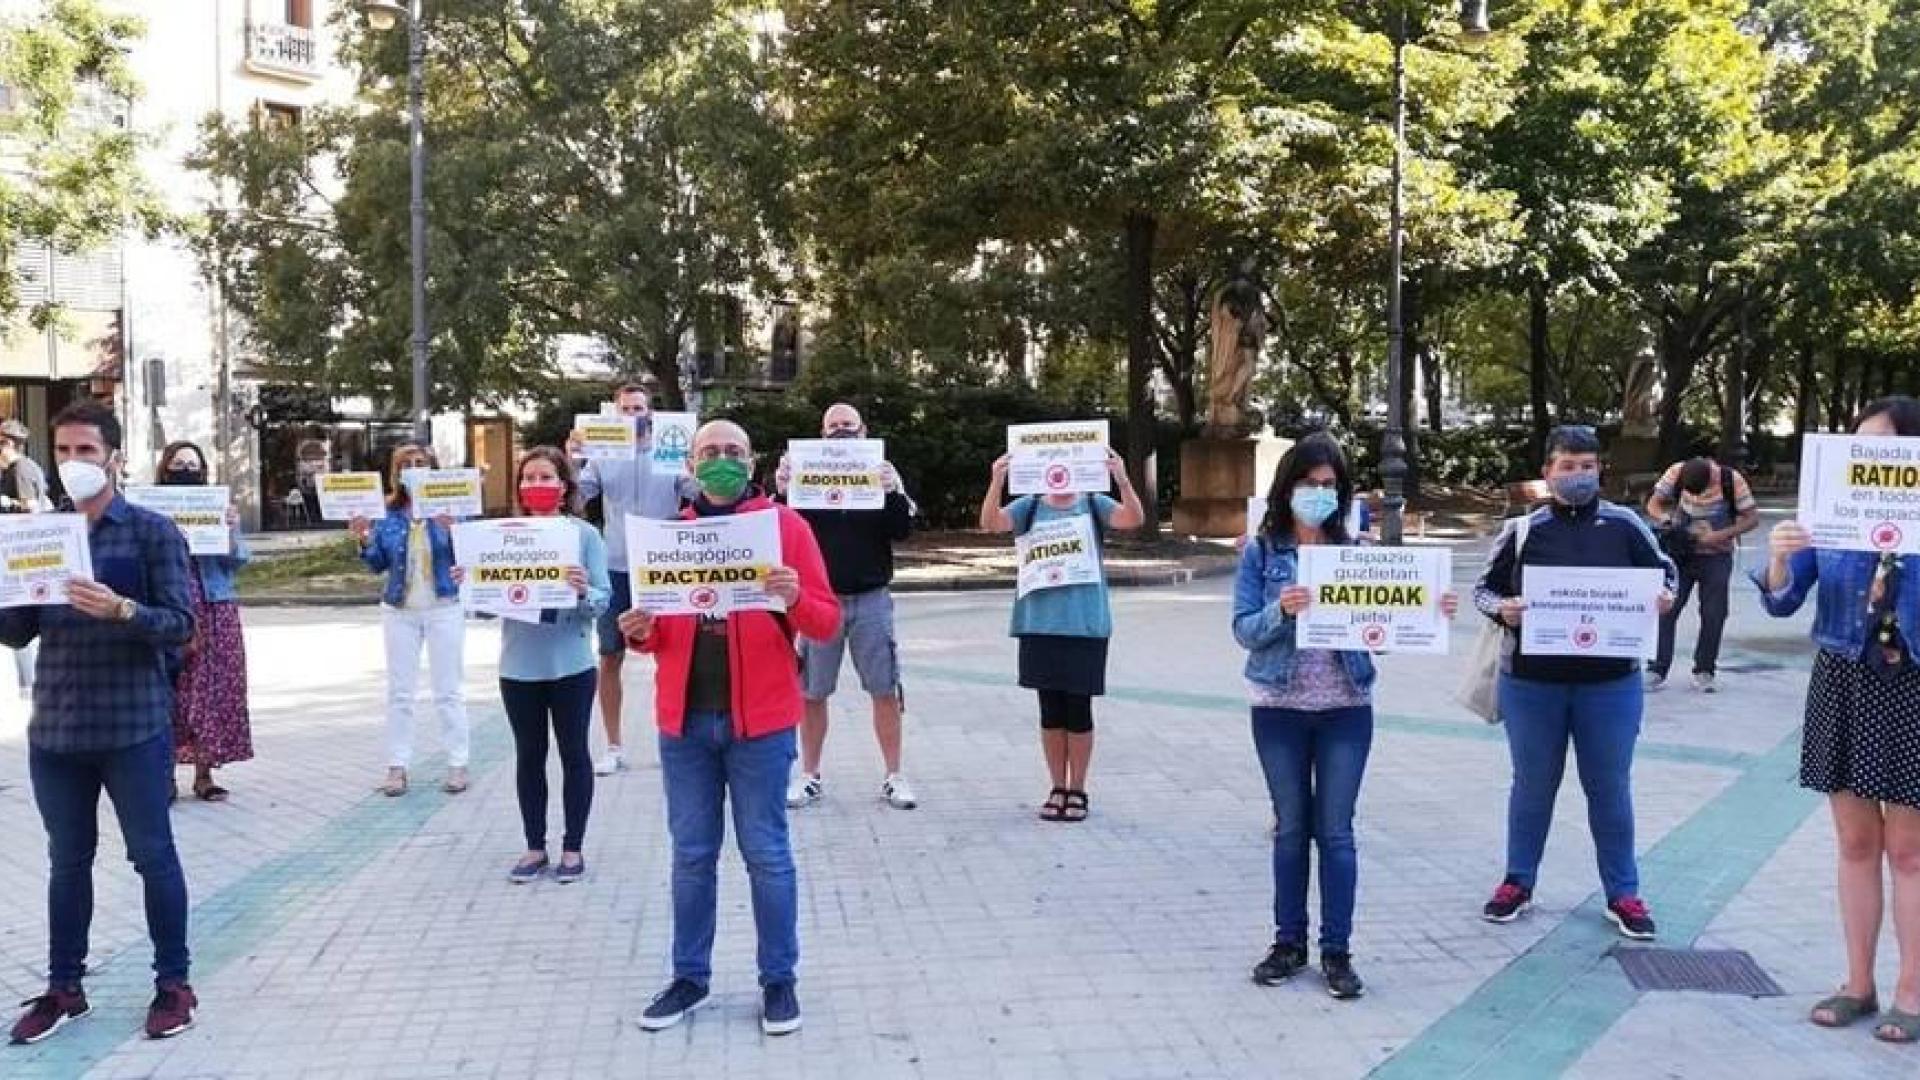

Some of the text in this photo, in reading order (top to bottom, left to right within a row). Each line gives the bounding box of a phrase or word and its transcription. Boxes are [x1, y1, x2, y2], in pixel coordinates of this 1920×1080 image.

[1850, 444, 1912, 461] Bajada
[801, 474, 870, 487] ADOSTUA
[1850, 463, 1920, 488] RATIO
[1851, 490, 1874, 502] en
[1833, 501, 1920, 521] los espac
[503, 533, 536, 545] Plan
[676, 530, 719, 545] Plan
[646, 546, 754, 565] pedagógico
[1339, 549, 1415, 565] Espazio
[479, 567, 561, 582] PACTADO
[647, 567, 758, 585] PACTADO
[1333, 565, 1421, 582] guztietan
[1318, 584, 1424, 606] RATIOAK
[1350, 611, 1392, 625] jaitsi
